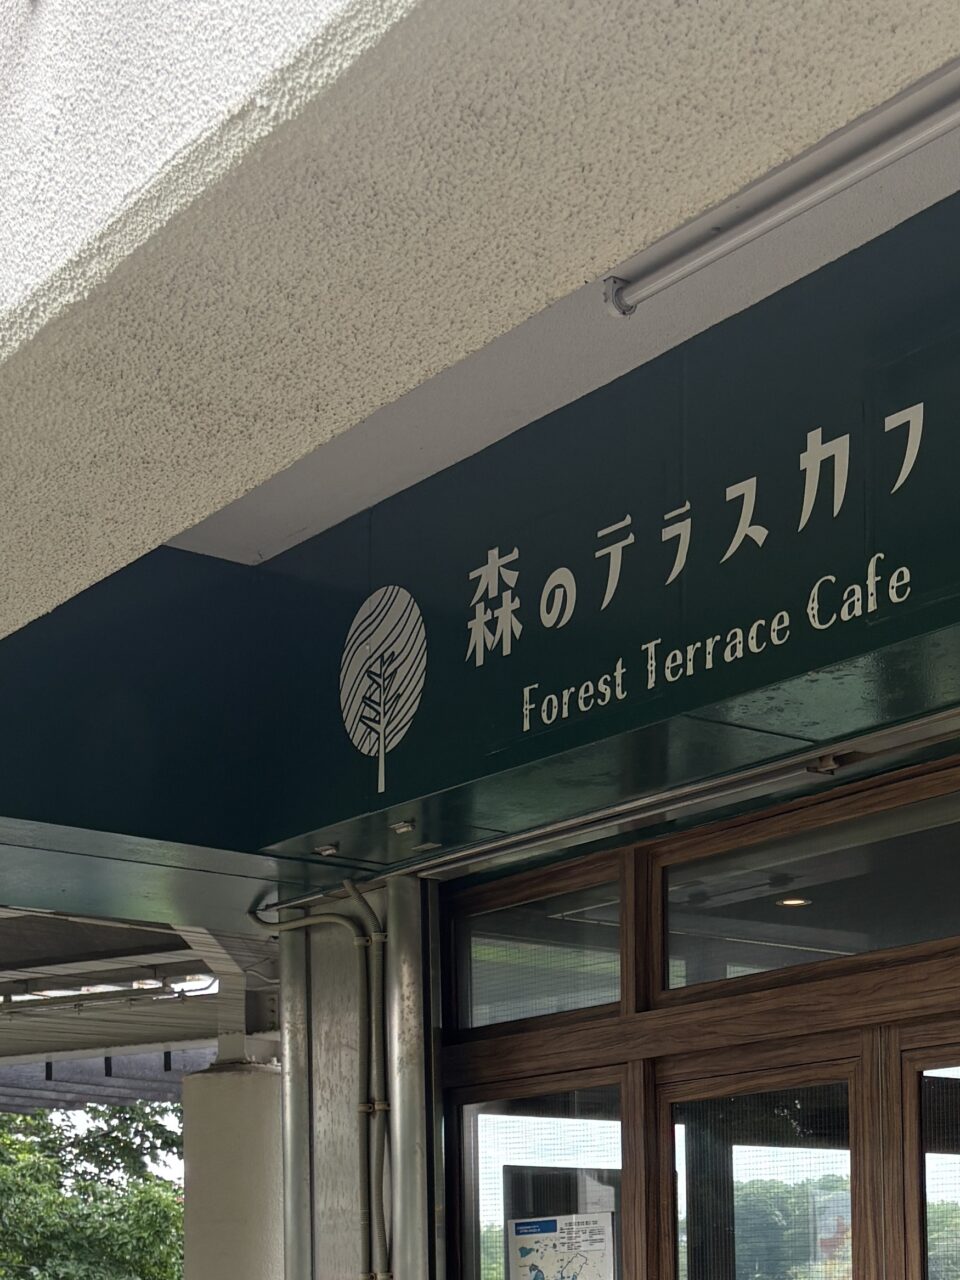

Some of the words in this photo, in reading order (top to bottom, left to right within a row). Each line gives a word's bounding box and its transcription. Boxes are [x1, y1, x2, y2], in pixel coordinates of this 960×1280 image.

[520, 656, 628, 733] Forest
[640, 607, 792, 691] Terrace
[806, 552, 912, 631] Cafe
